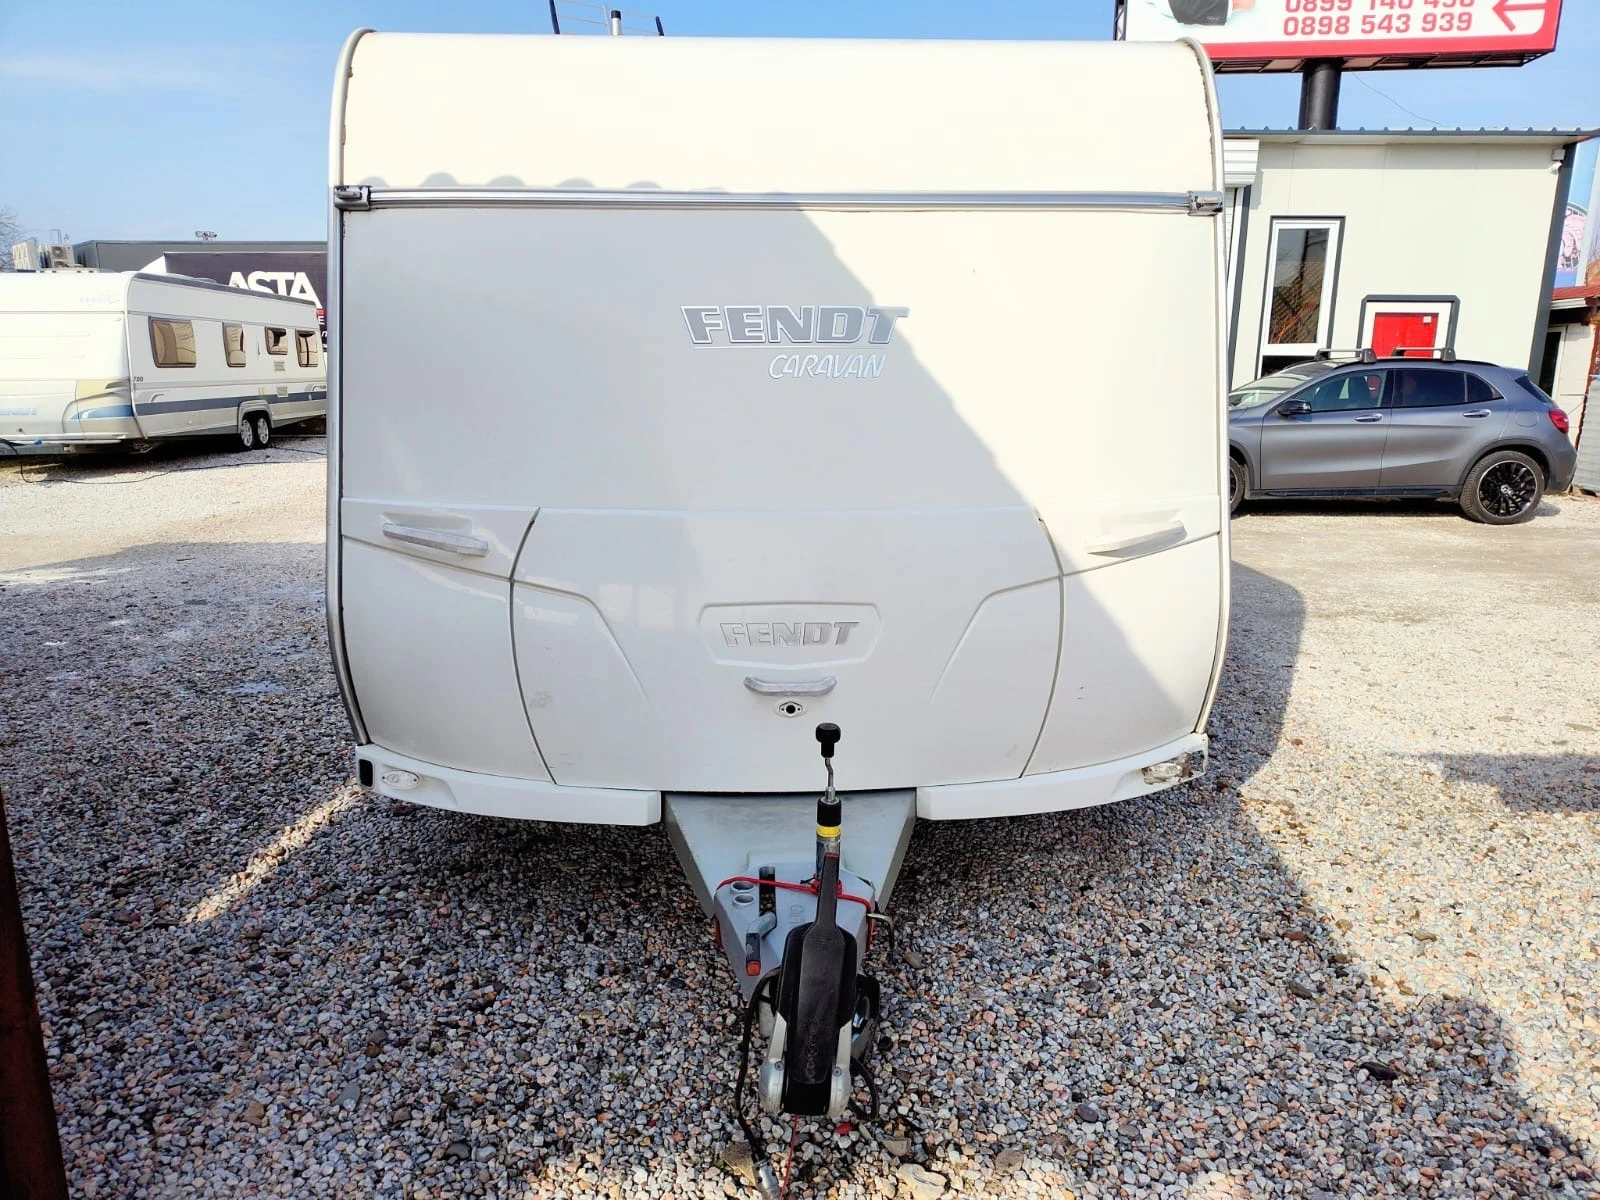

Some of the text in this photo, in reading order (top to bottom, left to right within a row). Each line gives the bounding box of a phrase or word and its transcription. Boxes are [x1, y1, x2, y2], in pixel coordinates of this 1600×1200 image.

[1285, 0, 1353, 12] 0899
[1283, 12, 1472, 35] 0898 543 939
[680, 305, 910, 344] FENDT
[768, 354, 887, 379] CARAVAN
[719, 622, 860, 648] FENDT
